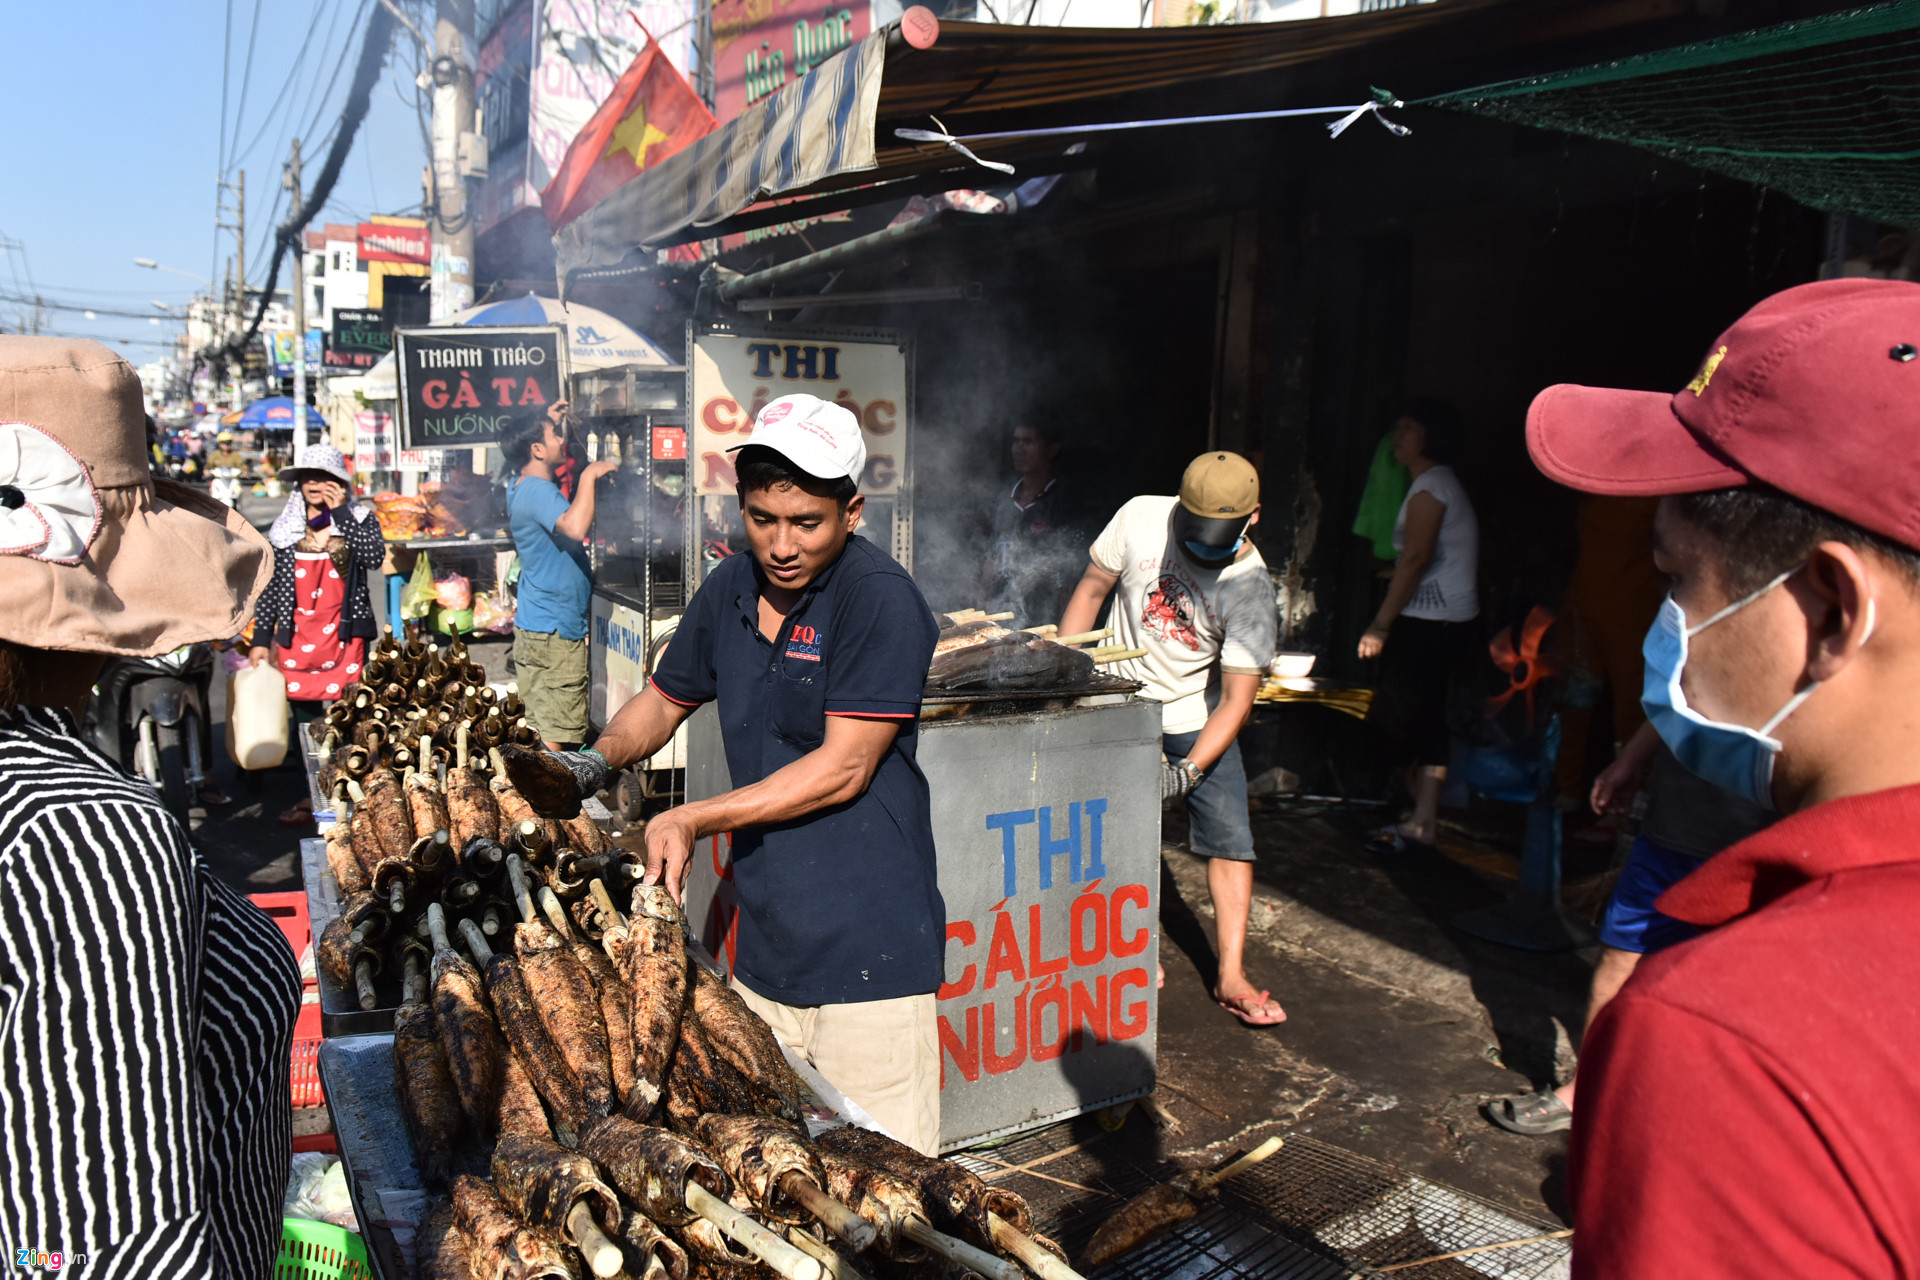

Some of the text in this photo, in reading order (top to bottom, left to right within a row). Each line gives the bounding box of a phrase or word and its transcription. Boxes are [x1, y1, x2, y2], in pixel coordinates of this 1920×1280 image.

[417, 341, 546, 369] THANH THẢO
[746, 341, 843, 382] THI
[421, 370, 547, 410] GÀ TA
[596, 615, 622, 655] THANH
[985, 797, 1108, 898] THI
[938, 966, 1149, 1091] NƯỚNG
